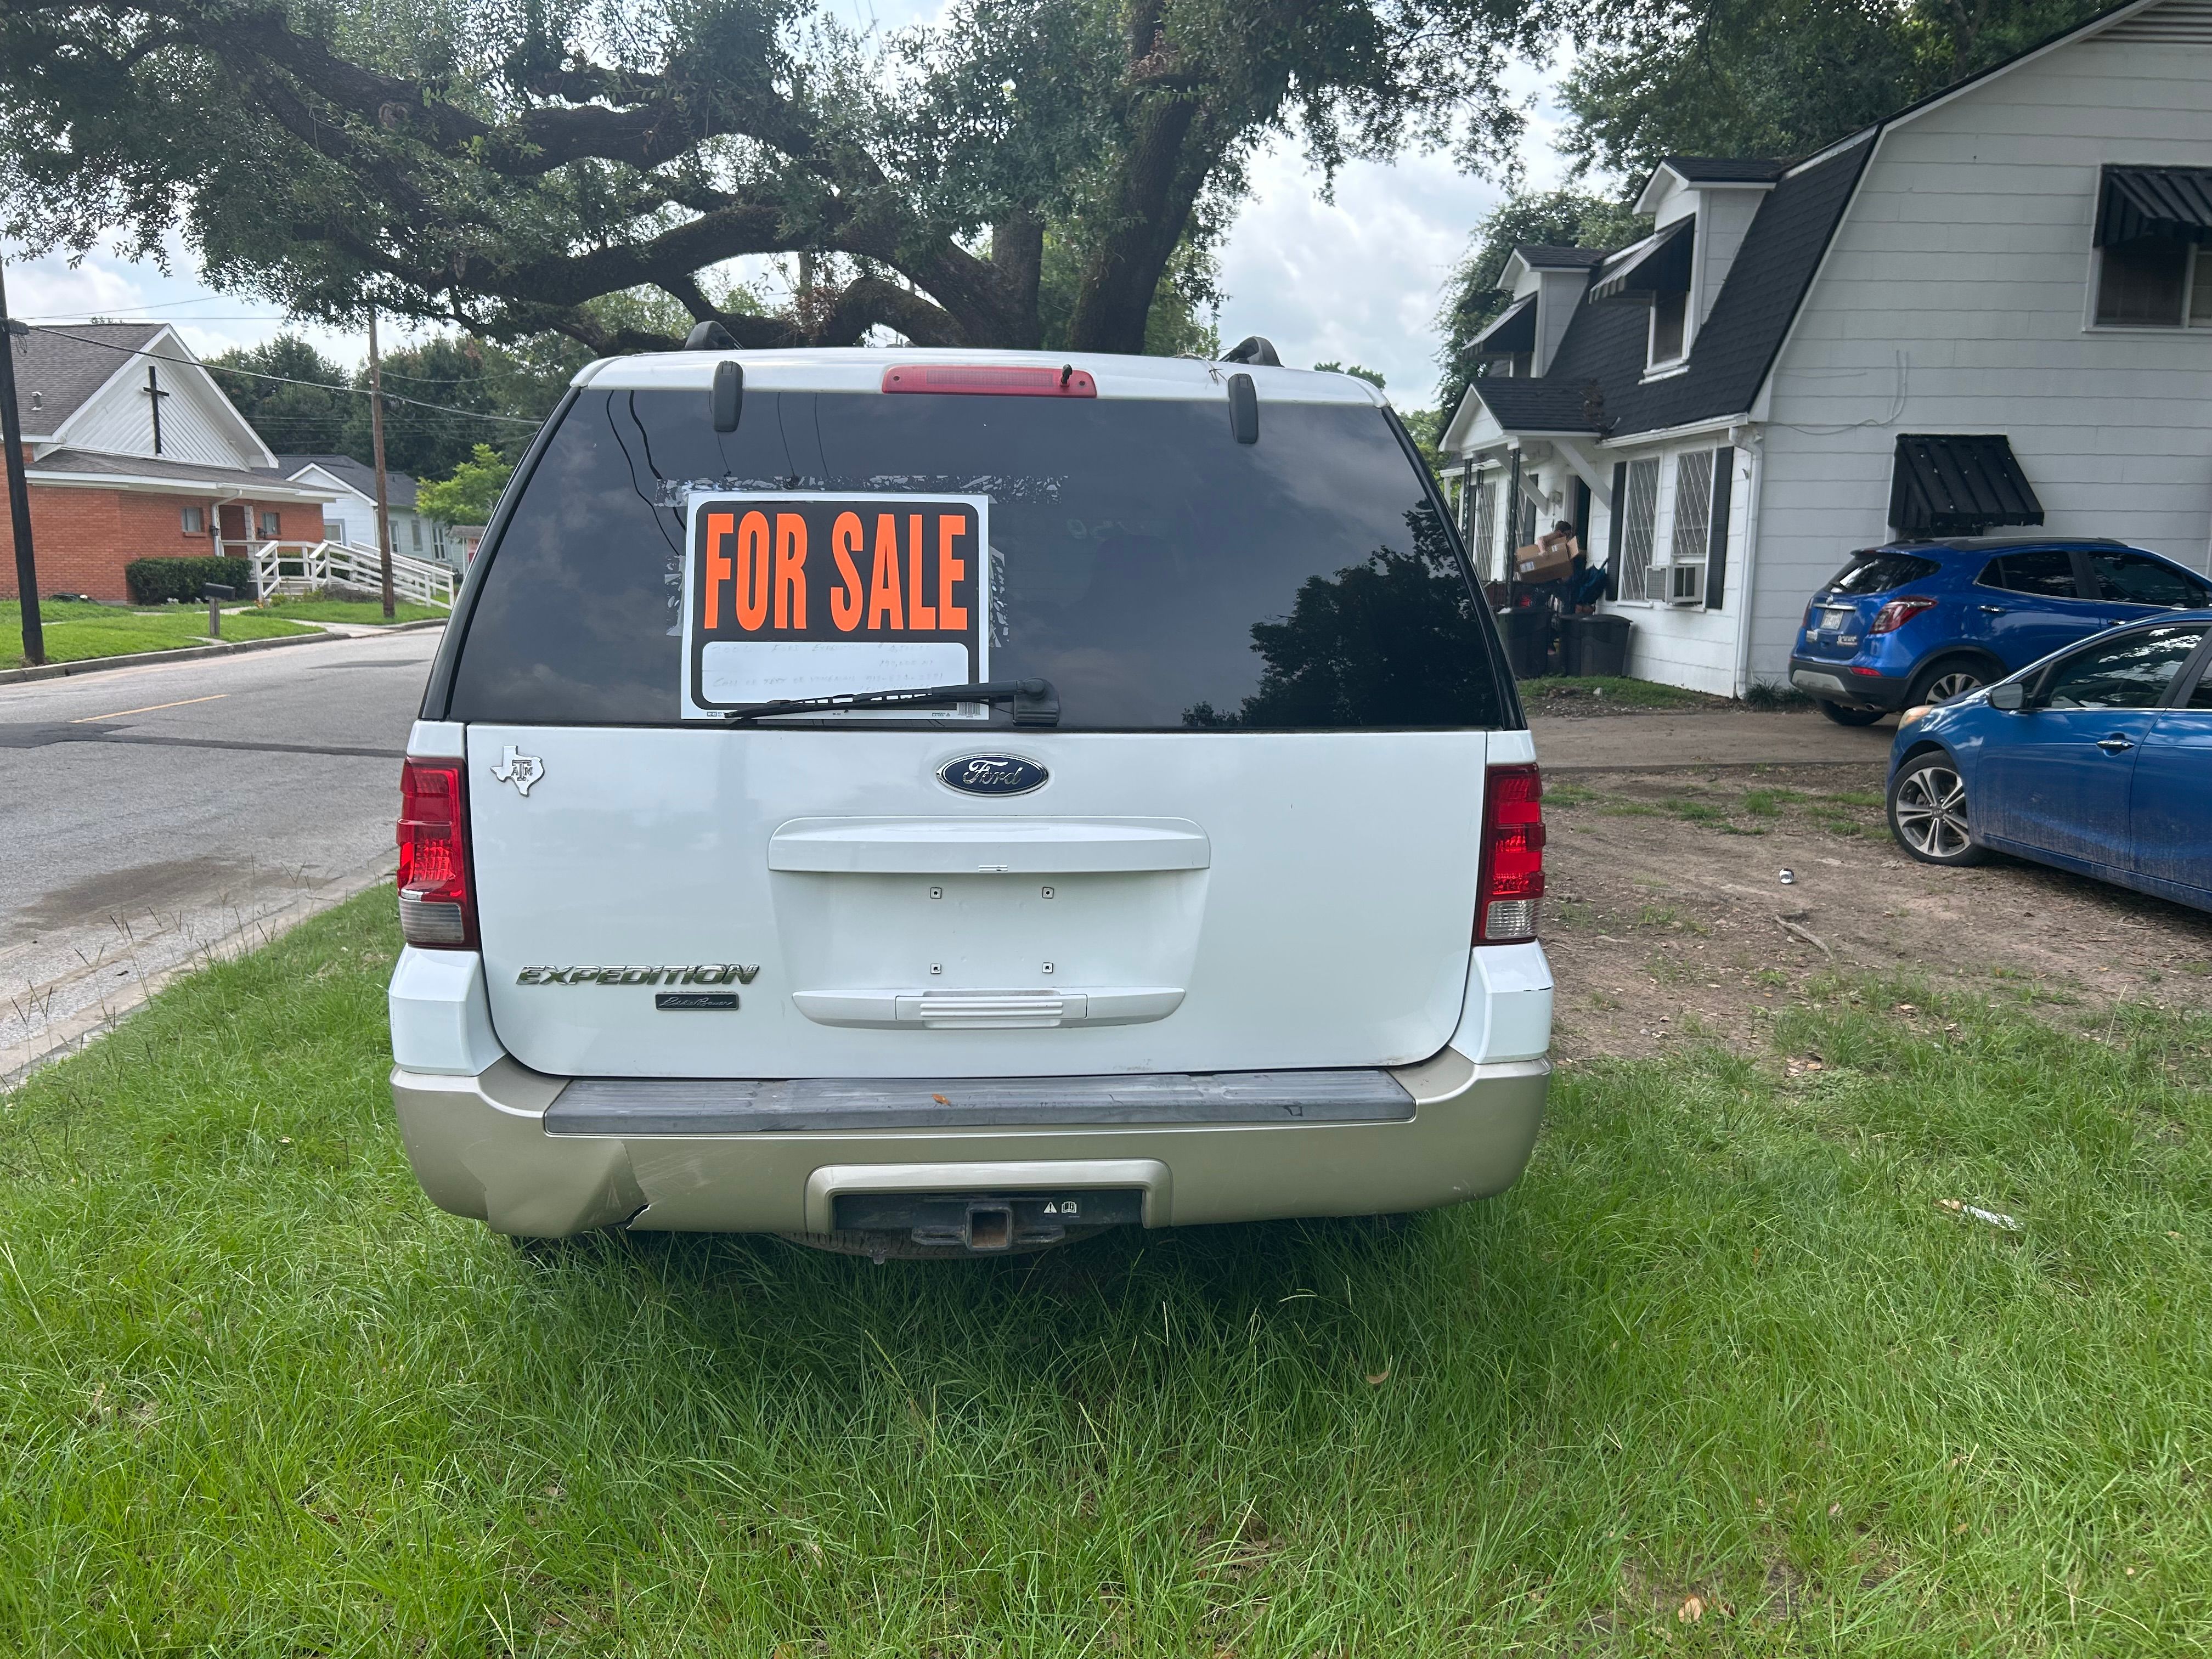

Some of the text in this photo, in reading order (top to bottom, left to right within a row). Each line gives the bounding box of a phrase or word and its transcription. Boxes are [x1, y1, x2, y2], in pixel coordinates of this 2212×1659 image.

[704, 510, 968, 632] FOR SALE
[962, 760, 1023, 785] Ford
[515, 964, 760, 985] EXPEDITION
[659, 996, 733, 1007] Eddie Bauer
